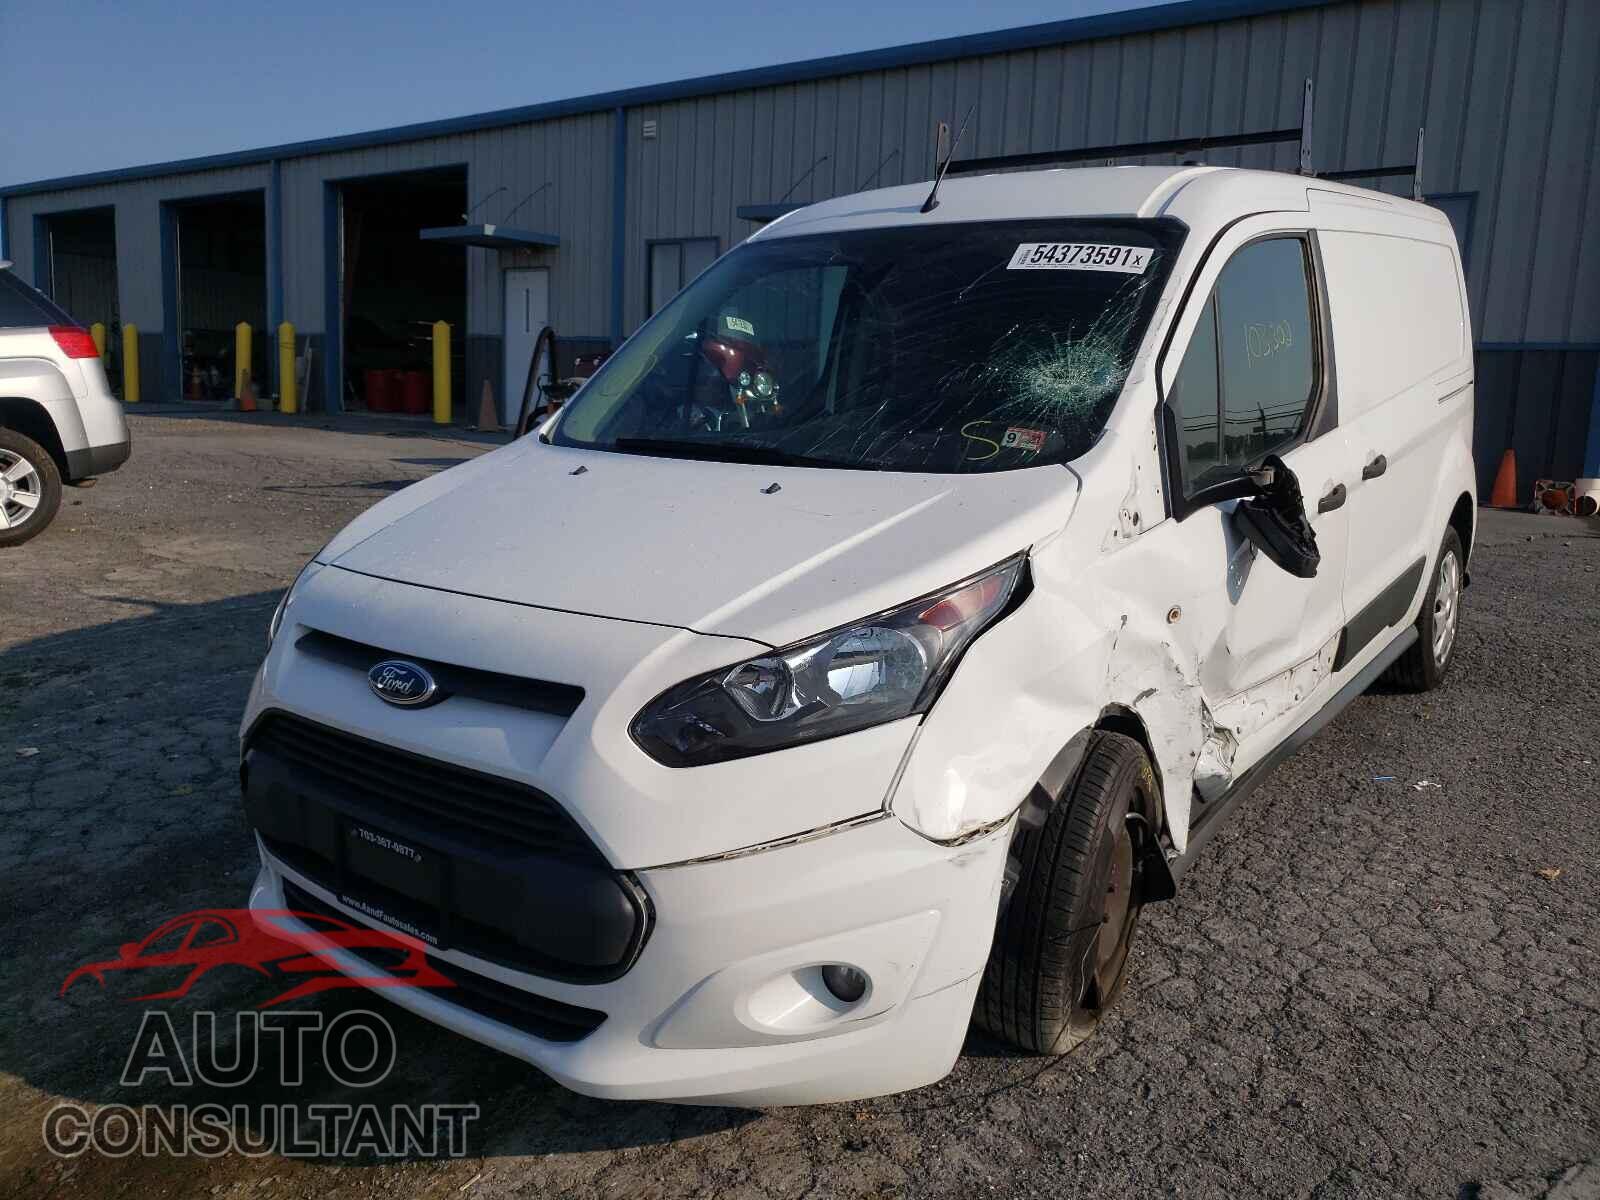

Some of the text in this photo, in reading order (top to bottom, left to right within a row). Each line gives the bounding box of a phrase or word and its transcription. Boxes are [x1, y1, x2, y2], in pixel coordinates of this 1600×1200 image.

[1030, 244, 1134, 266] 54373591
[960, 420, 1000, 461] S
[1005, 432, 1018, 444] 9
[377, 666, 416, 695] Ford
